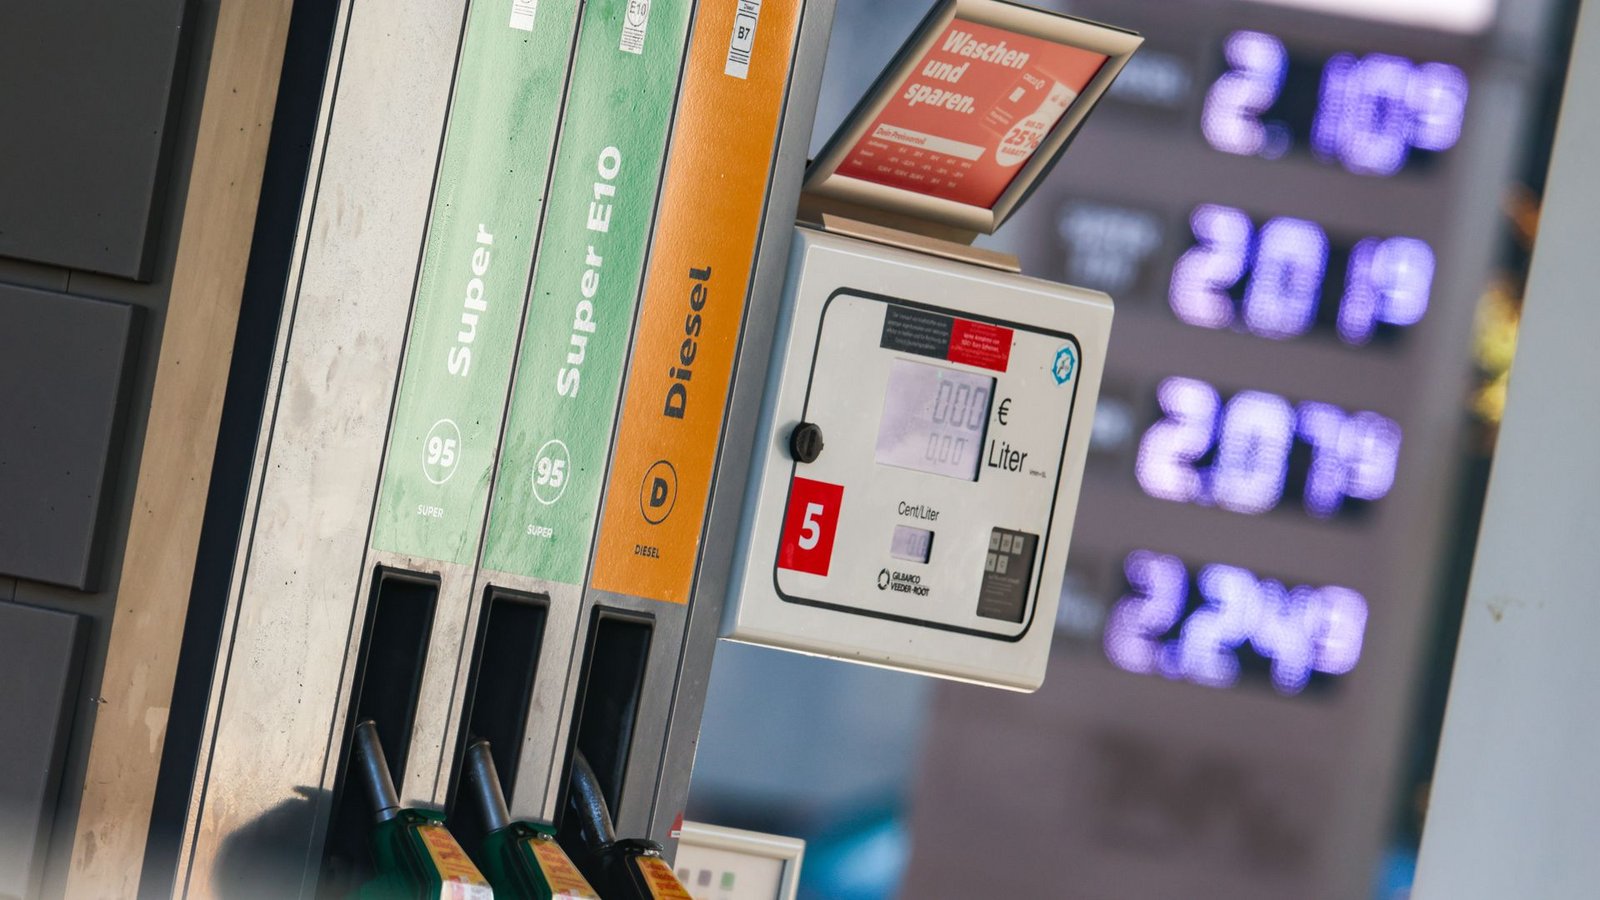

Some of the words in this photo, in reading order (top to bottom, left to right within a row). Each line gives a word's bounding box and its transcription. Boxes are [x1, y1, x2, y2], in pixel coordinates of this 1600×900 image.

[630, 0, 647, 16] E10
[737, 25, 751, 41] B7
[941, 30, 1030, 70] Waschen
[922, 59, 968, 84] und
[903, 82, 976, 115] sparen.
[876, 127, 892, 137] Dein
[556, 245, 603, 398] Super
[586, 146, 622, 233] E10
[447, 223, 494, 377] Super
[663, 265, 712, 420] Diesel
[997, 398, 1012, 426] €
[427, 436, 457, 467] 95
[988, 439, 1028, 473] Liter
[536, 457, 566, 488] 95
[649, 477, 668, 508] D
[417, 504, 444, 519] SUPER
[898, 500, 940, 521] Cent/Liter
[526, 524, 553, 539] SUPER
[798, 502, 824, 551] 5
[634, 544, 660, 559] DIESEL
[890, 582, 930, 597] VEEDER-ROOT
[892, 571, 921, 584] GILBARCO
